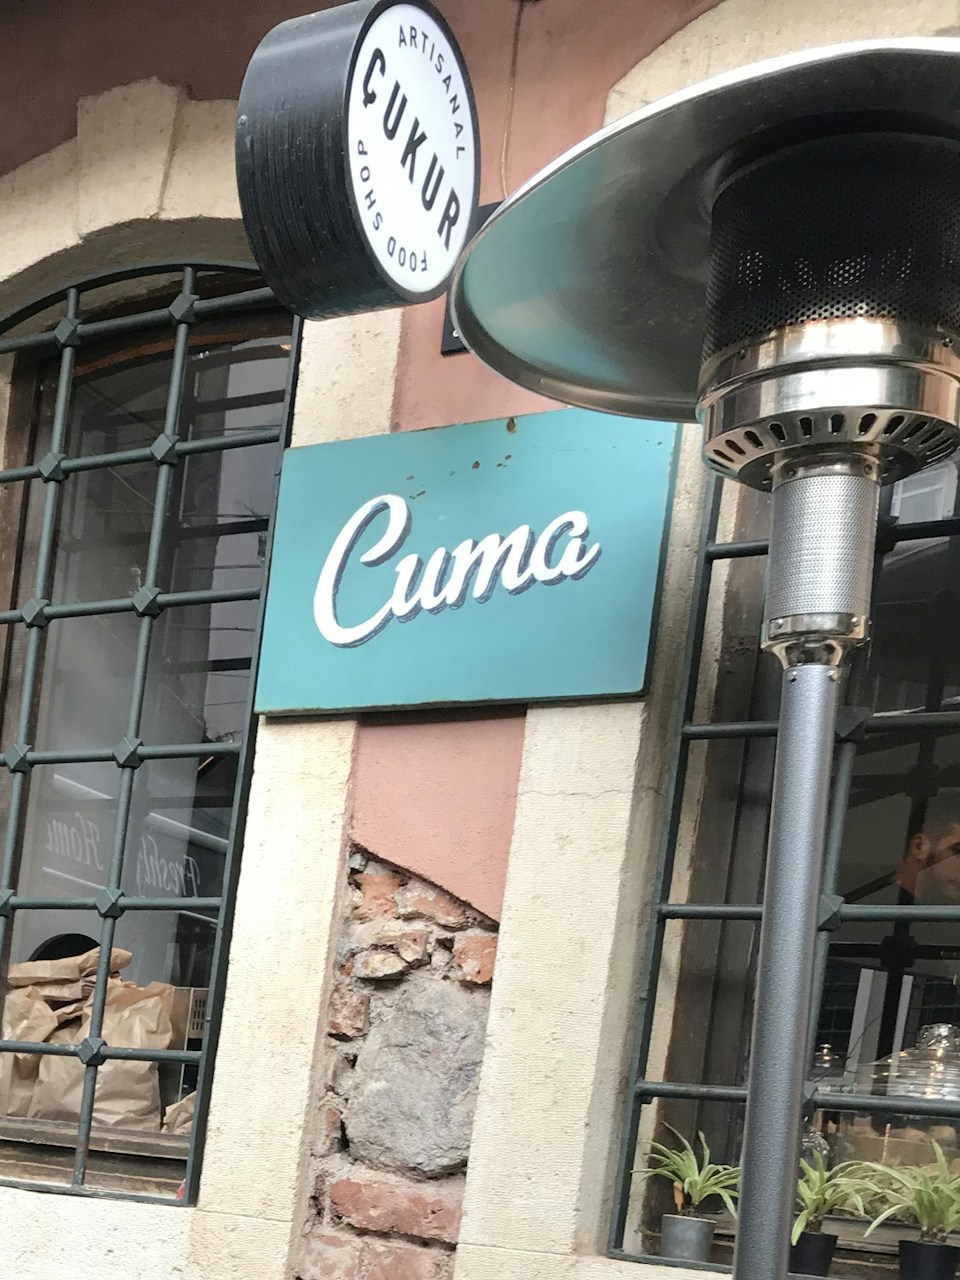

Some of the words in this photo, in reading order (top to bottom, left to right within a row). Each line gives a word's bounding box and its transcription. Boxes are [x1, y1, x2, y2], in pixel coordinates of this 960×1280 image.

[362, 47, 461, 251] ÇUKUR
[398, 24, 466, 160] ARTISANAL
[357, 139, 383, 231] SHOP
[387, 236, 428, 273] FOOD
[313, 493, 602, 649] Cuma
